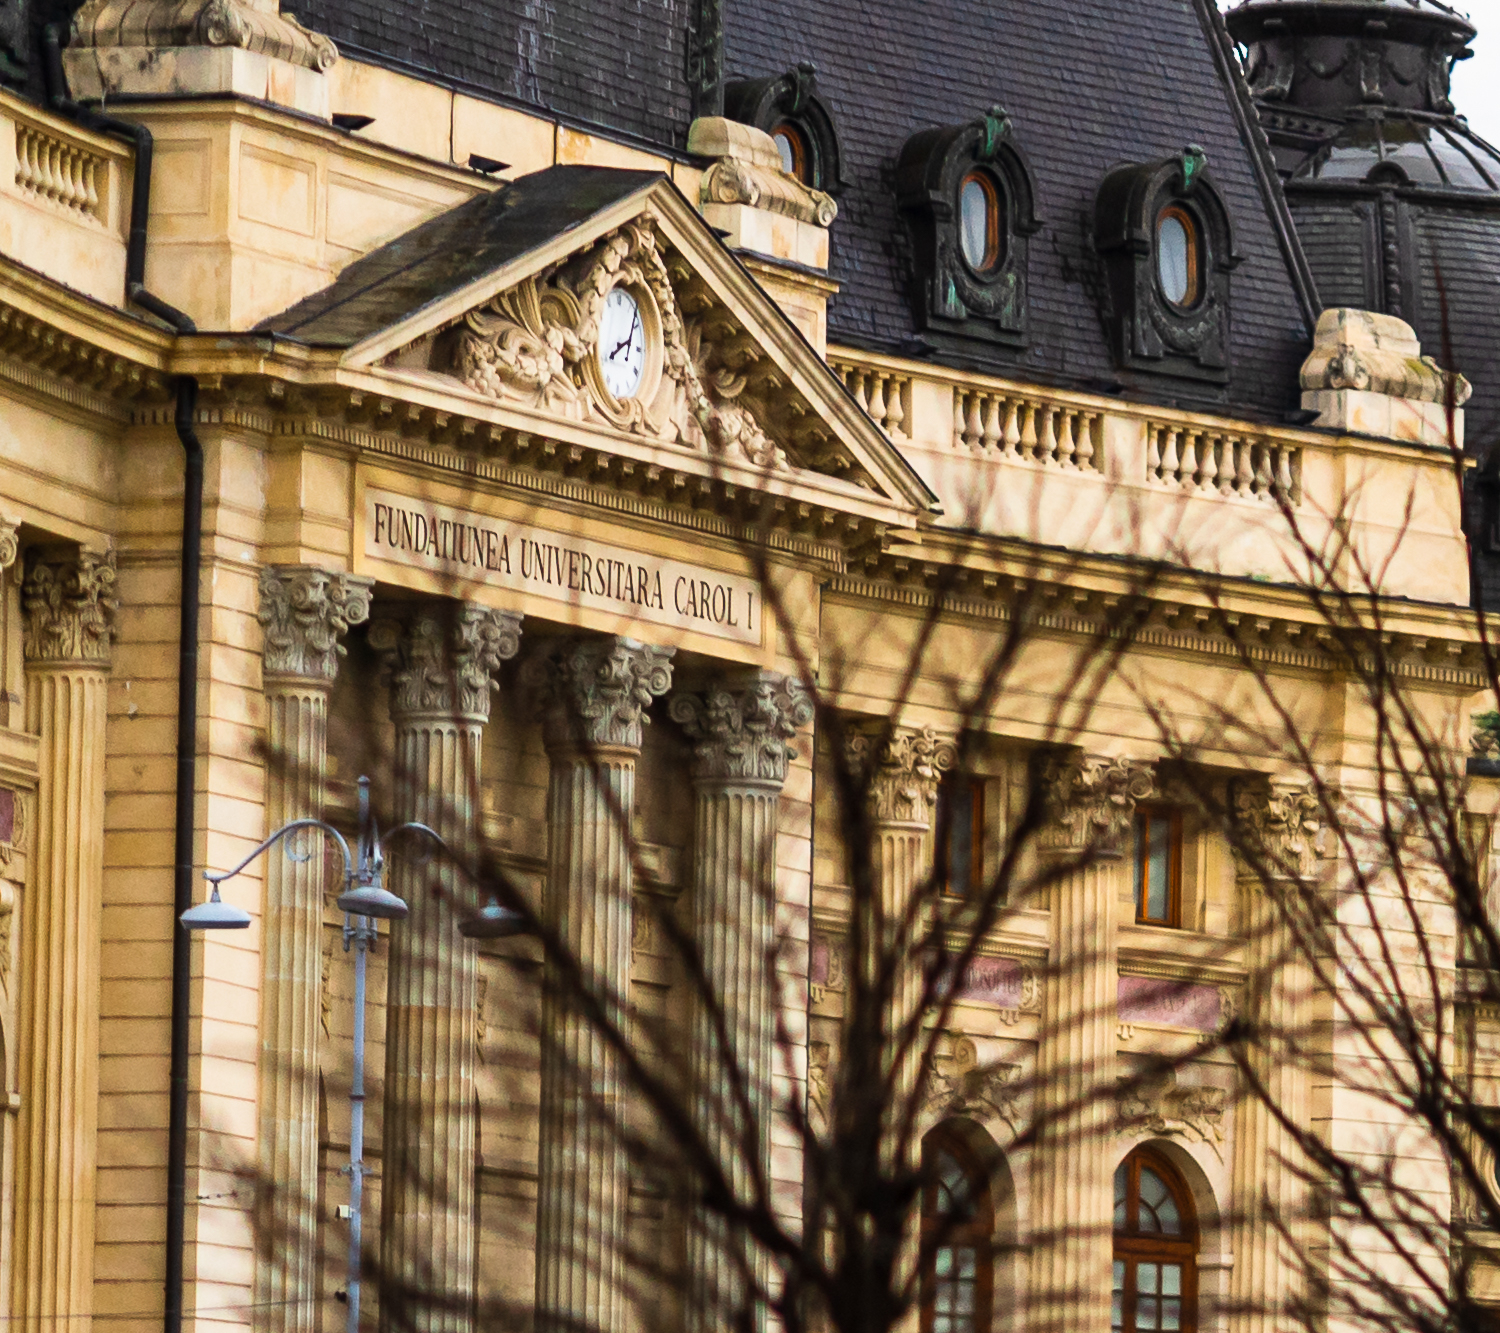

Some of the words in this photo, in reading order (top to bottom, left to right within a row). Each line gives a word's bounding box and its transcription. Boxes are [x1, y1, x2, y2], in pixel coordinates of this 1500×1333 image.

[374, 502, 511, 575] FUNDATIUNEA
[520, 538, 664, 611] UNIVERSITARA
[673, 575, 738, 627] CAROL
[746, 591, 754, 630] I
